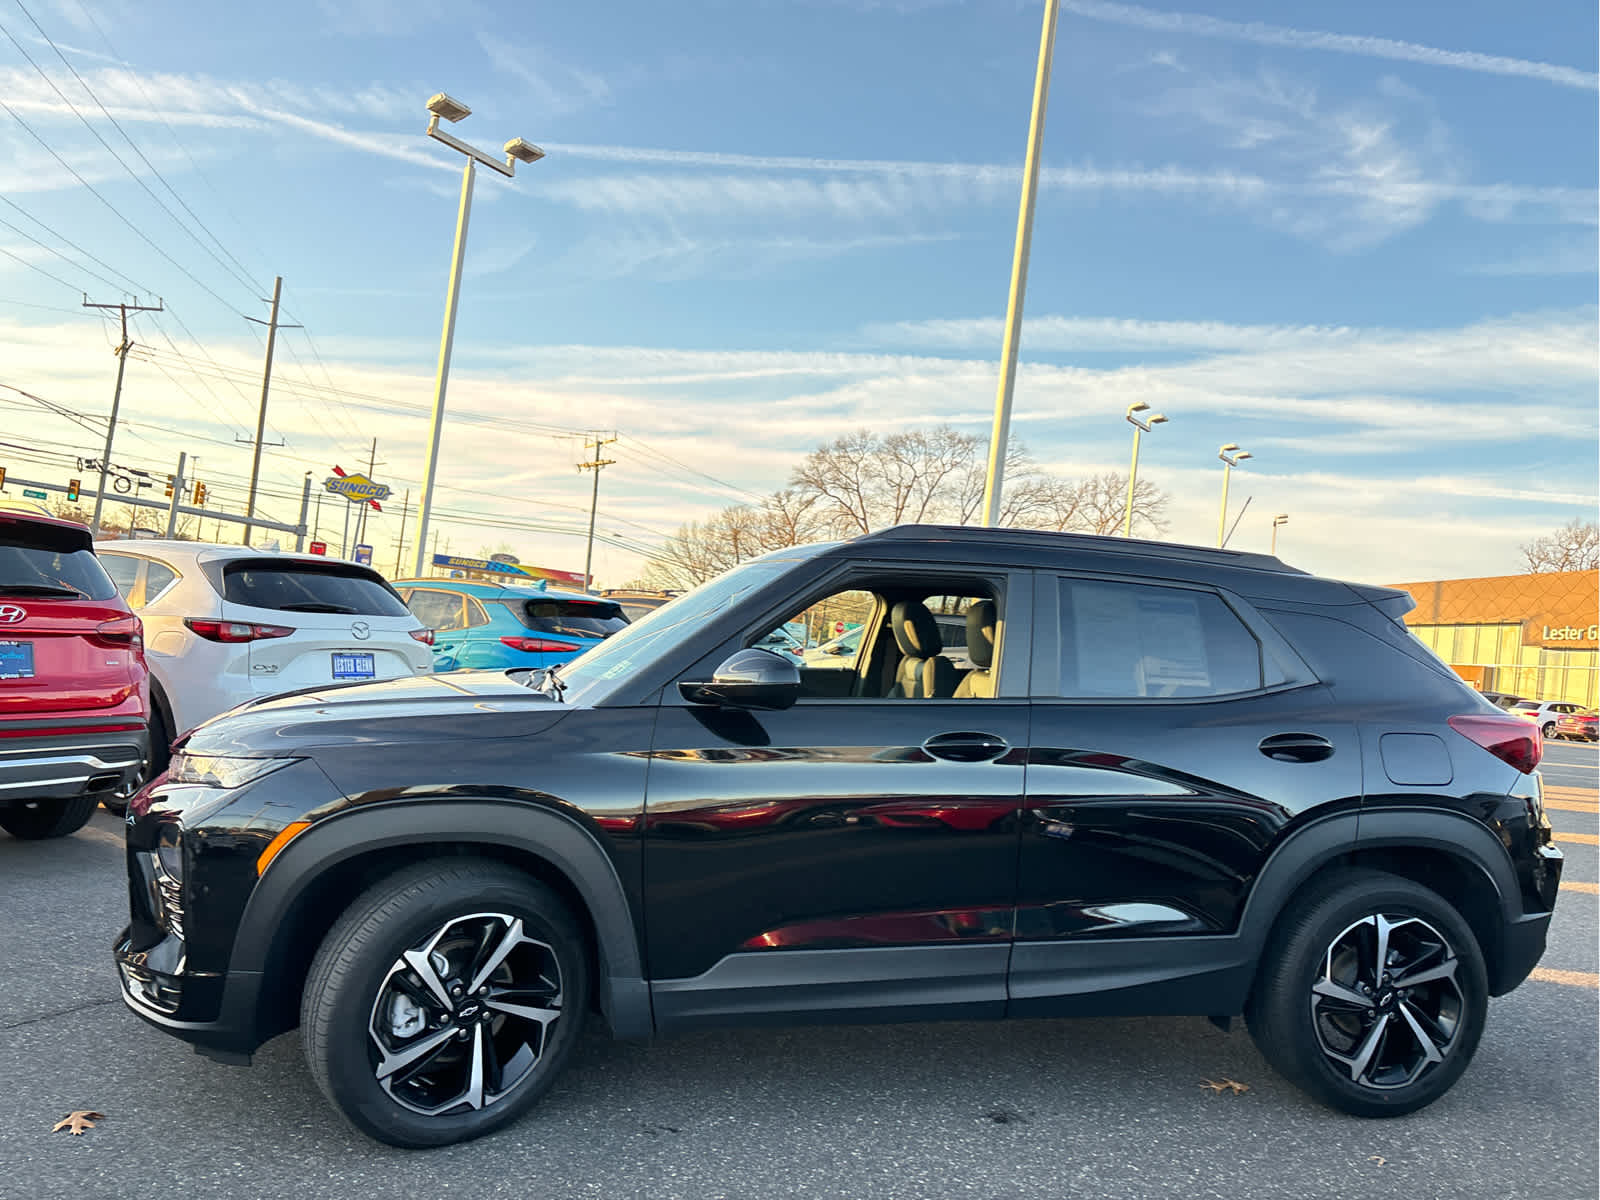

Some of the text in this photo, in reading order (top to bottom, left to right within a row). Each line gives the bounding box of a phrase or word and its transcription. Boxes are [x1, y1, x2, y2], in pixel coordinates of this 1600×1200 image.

[328, 480, 386, 497] SUNOCO
[448, 557, 488, 568] SUNOCO
[1543, 625, 1585, 640] Lester
